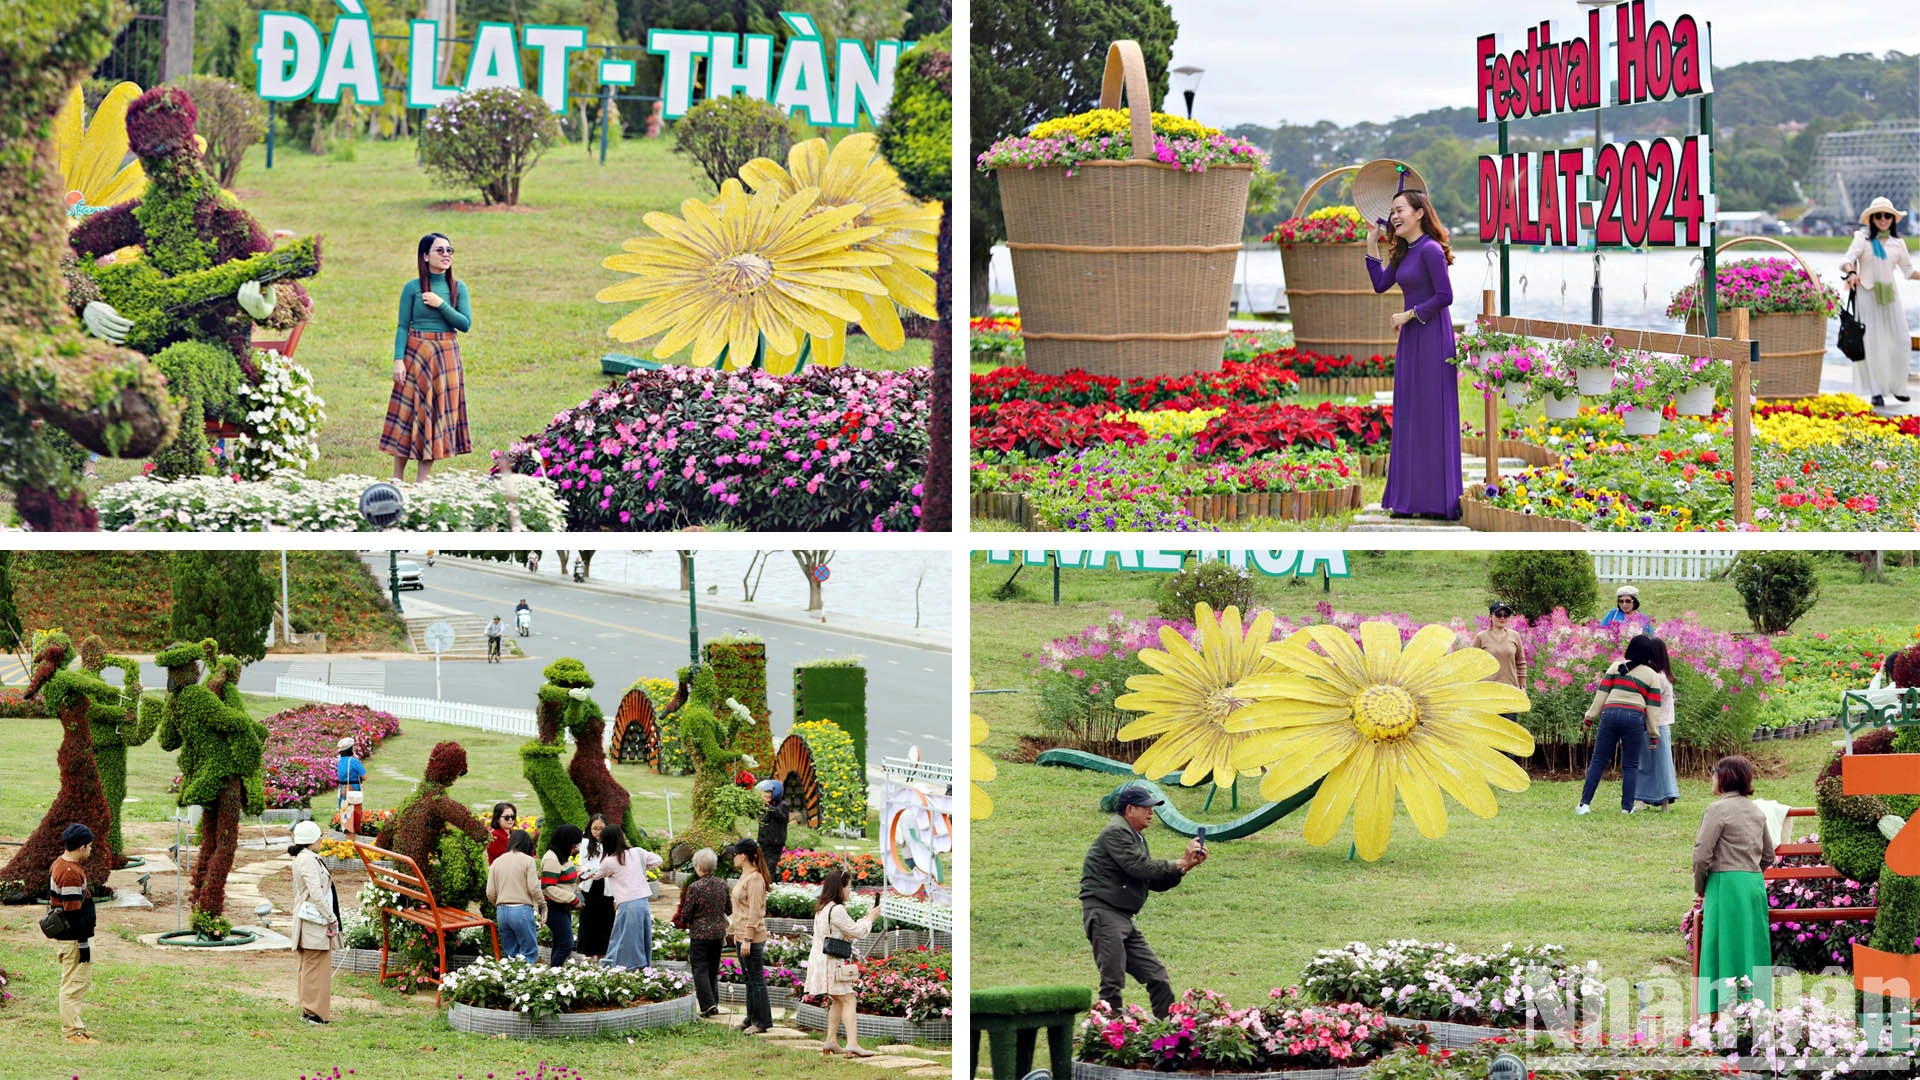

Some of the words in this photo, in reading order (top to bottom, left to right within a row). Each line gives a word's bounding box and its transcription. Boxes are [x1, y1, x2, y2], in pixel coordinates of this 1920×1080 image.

[253, 0, 384, 106] ĐÀ
[599, 44, 635, 86] -
[1477, 8, 1601, 124] Festival
[1615, 0, 1704, 105] Hoa
